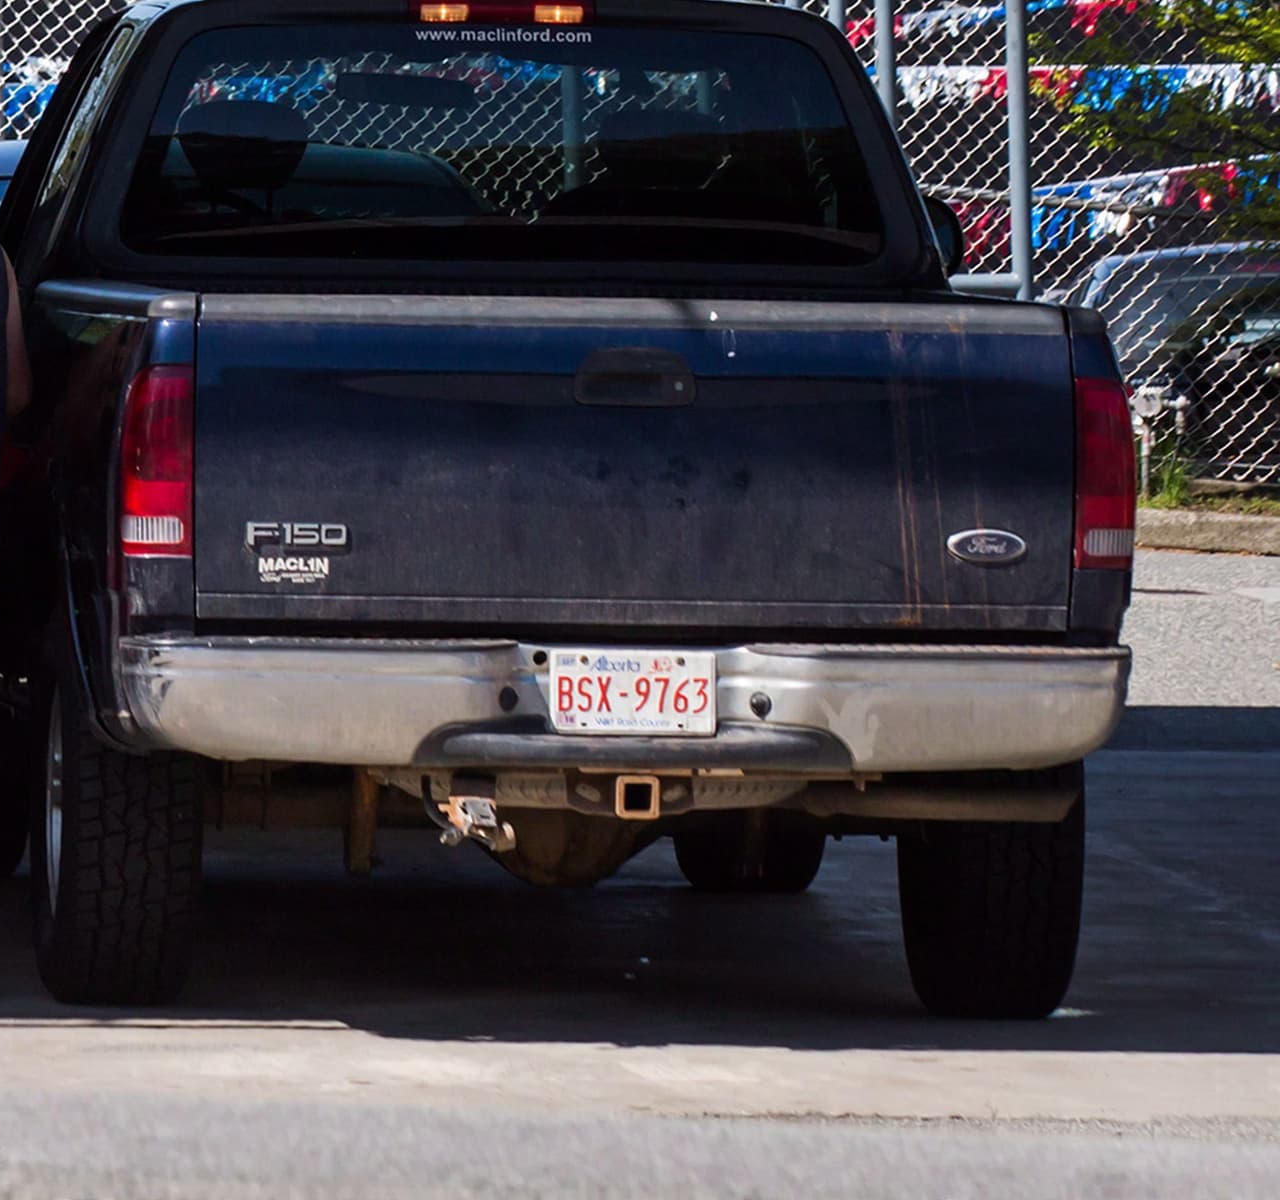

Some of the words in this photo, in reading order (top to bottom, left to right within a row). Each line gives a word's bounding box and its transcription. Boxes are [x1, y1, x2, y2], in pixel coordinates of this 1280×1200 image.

[416, 28, 592, 43] www.maclinford.com
[591, 655, 641, 673] Alberta
[558, 675, 709, 714] BSX-9763
